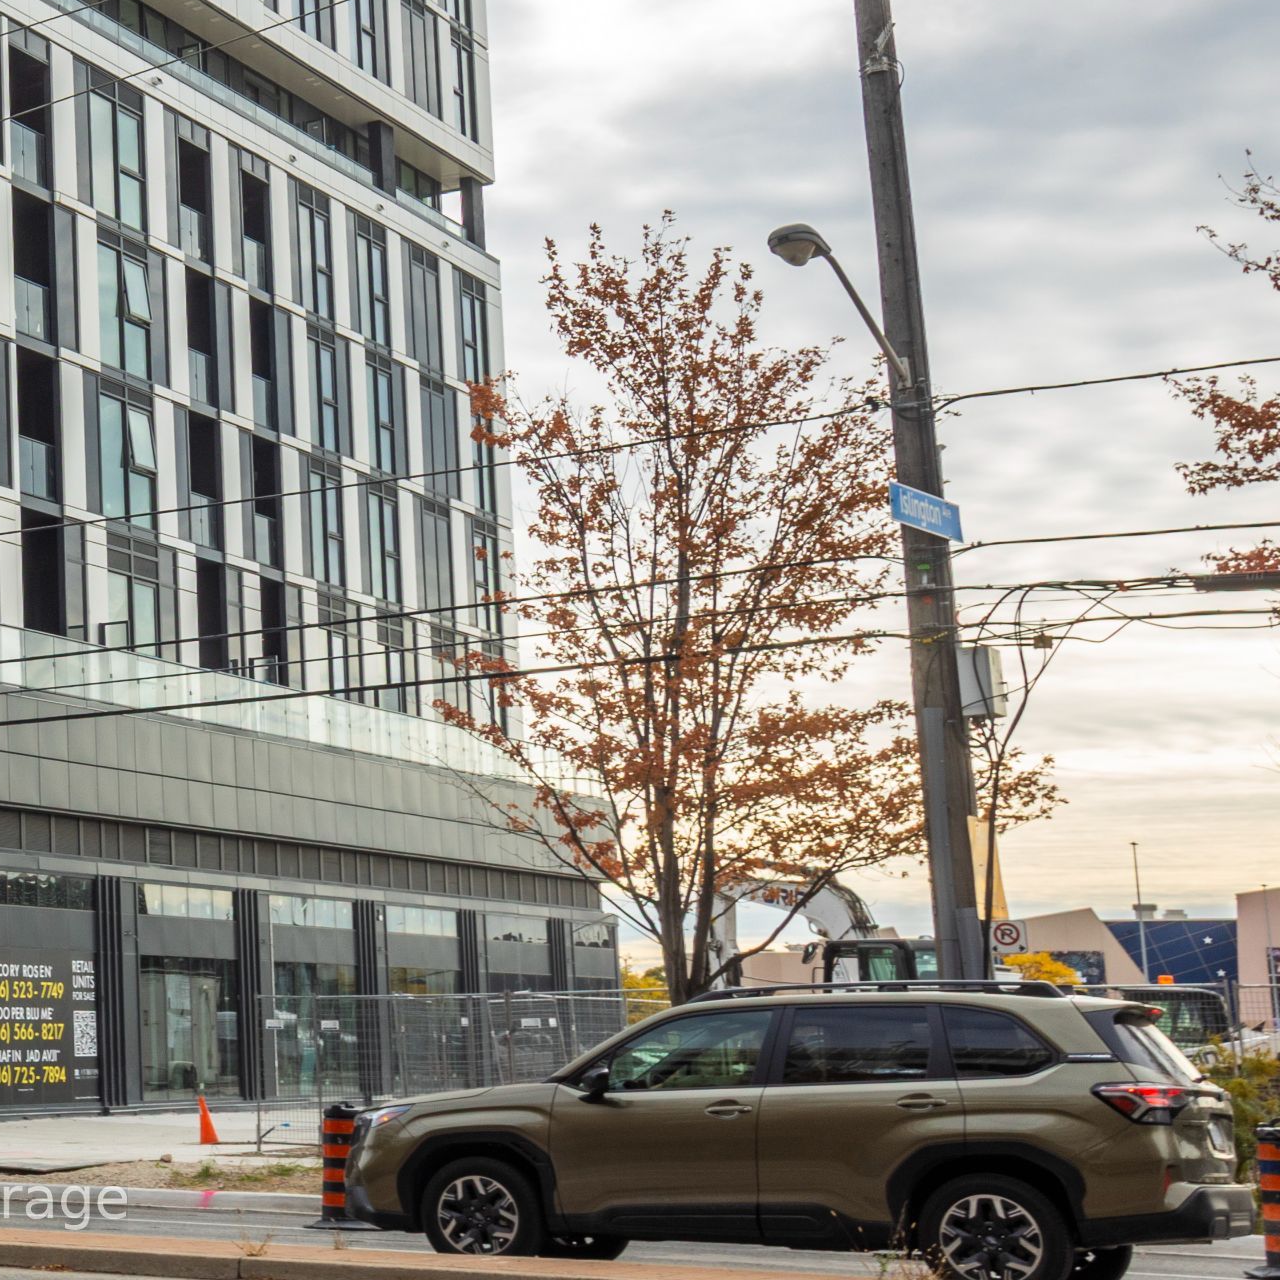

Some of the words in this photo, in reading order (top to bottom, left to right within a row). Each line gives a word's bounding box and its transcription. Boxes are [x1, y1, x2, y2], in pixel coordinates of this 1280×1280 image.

[899, 488, 942, 527] Islington
[71, 960, 95, 974] RETAIL
[72, 975, 96, 989] UNITS
